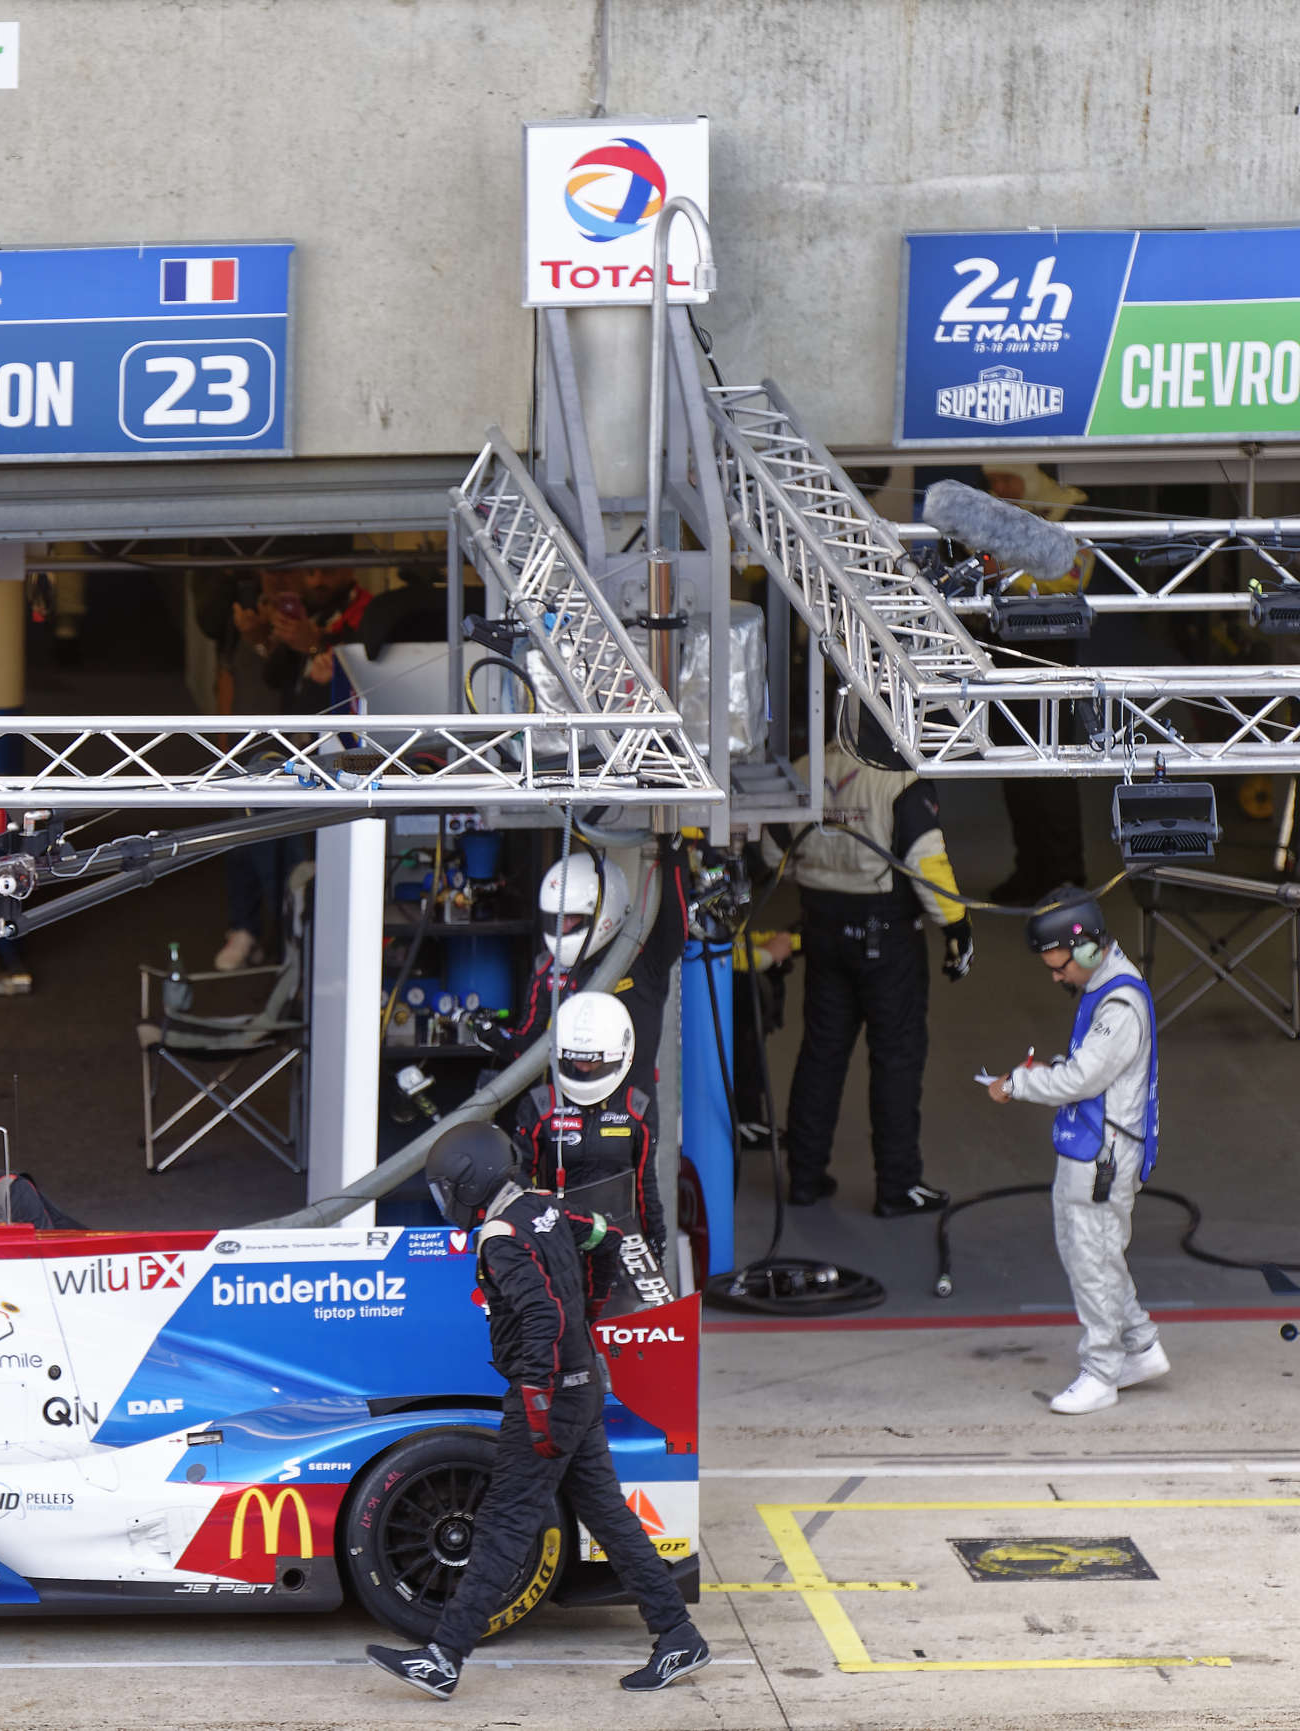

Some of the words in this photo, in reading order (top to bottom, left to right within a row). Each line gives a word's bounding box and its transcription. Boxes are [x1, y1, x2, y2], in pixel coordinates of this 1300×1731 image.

[939, 255, 1073, 322] 24h
[934, 324, 973, 342] LE
[975, 323, 1064, 342] MANS
[143, 355, 251, 426] 23
[939, 381, 1061, 422] SUPERFINALE
[212, 1271, 406, 1306] binderholz
[314, 1306, 356, 1321] tiptop
[359, 1305, 405, 1318] timber
[596, 1325, 685, 1344] TOTAL
[127, 1398, 184, 1416] DAF
[308, 1462, 351, 1472] SERFIM
[26, 1493, 75, 1505] PELLETS
[174, 1583, 212, 1594] JS
